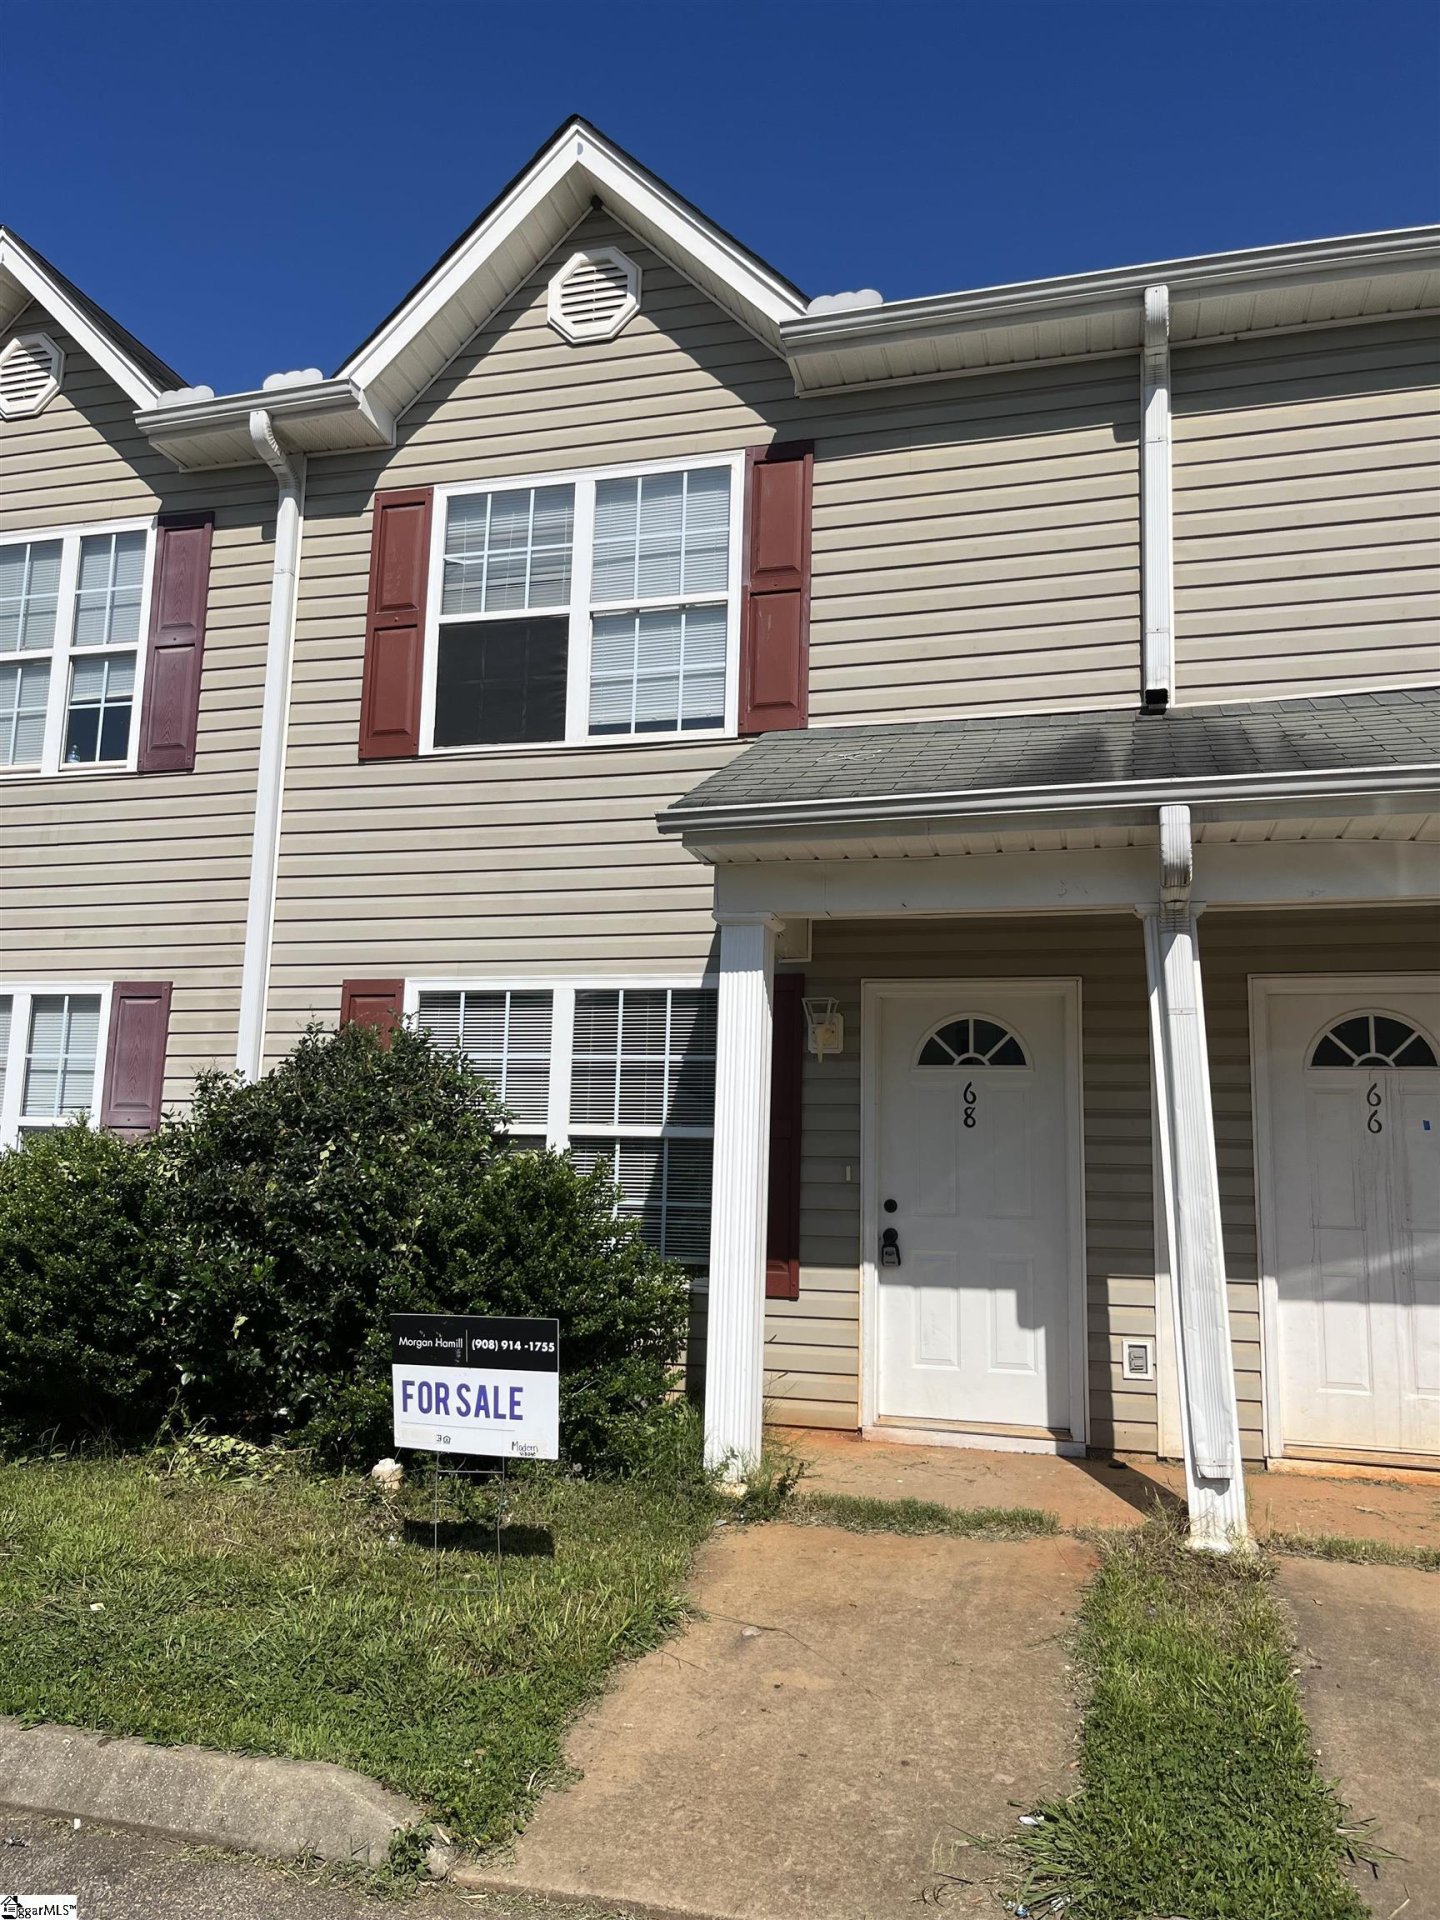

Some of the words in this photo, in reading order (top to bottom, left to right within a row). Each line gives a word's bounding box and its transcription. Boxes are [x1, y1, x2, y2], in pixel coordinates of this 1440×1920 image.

[398, 1336, 433, 1350] Morgan
[435, 1337, 463, 1349] Hamill
[471, 1338, 499, 1352] (908)
[501, 1340, 522, 1351] 914
[524, 1341, 555, 1353] -1755
[402, 1380, 450, 1416] FOR
[456, 1383, 524, 1421] SALE
